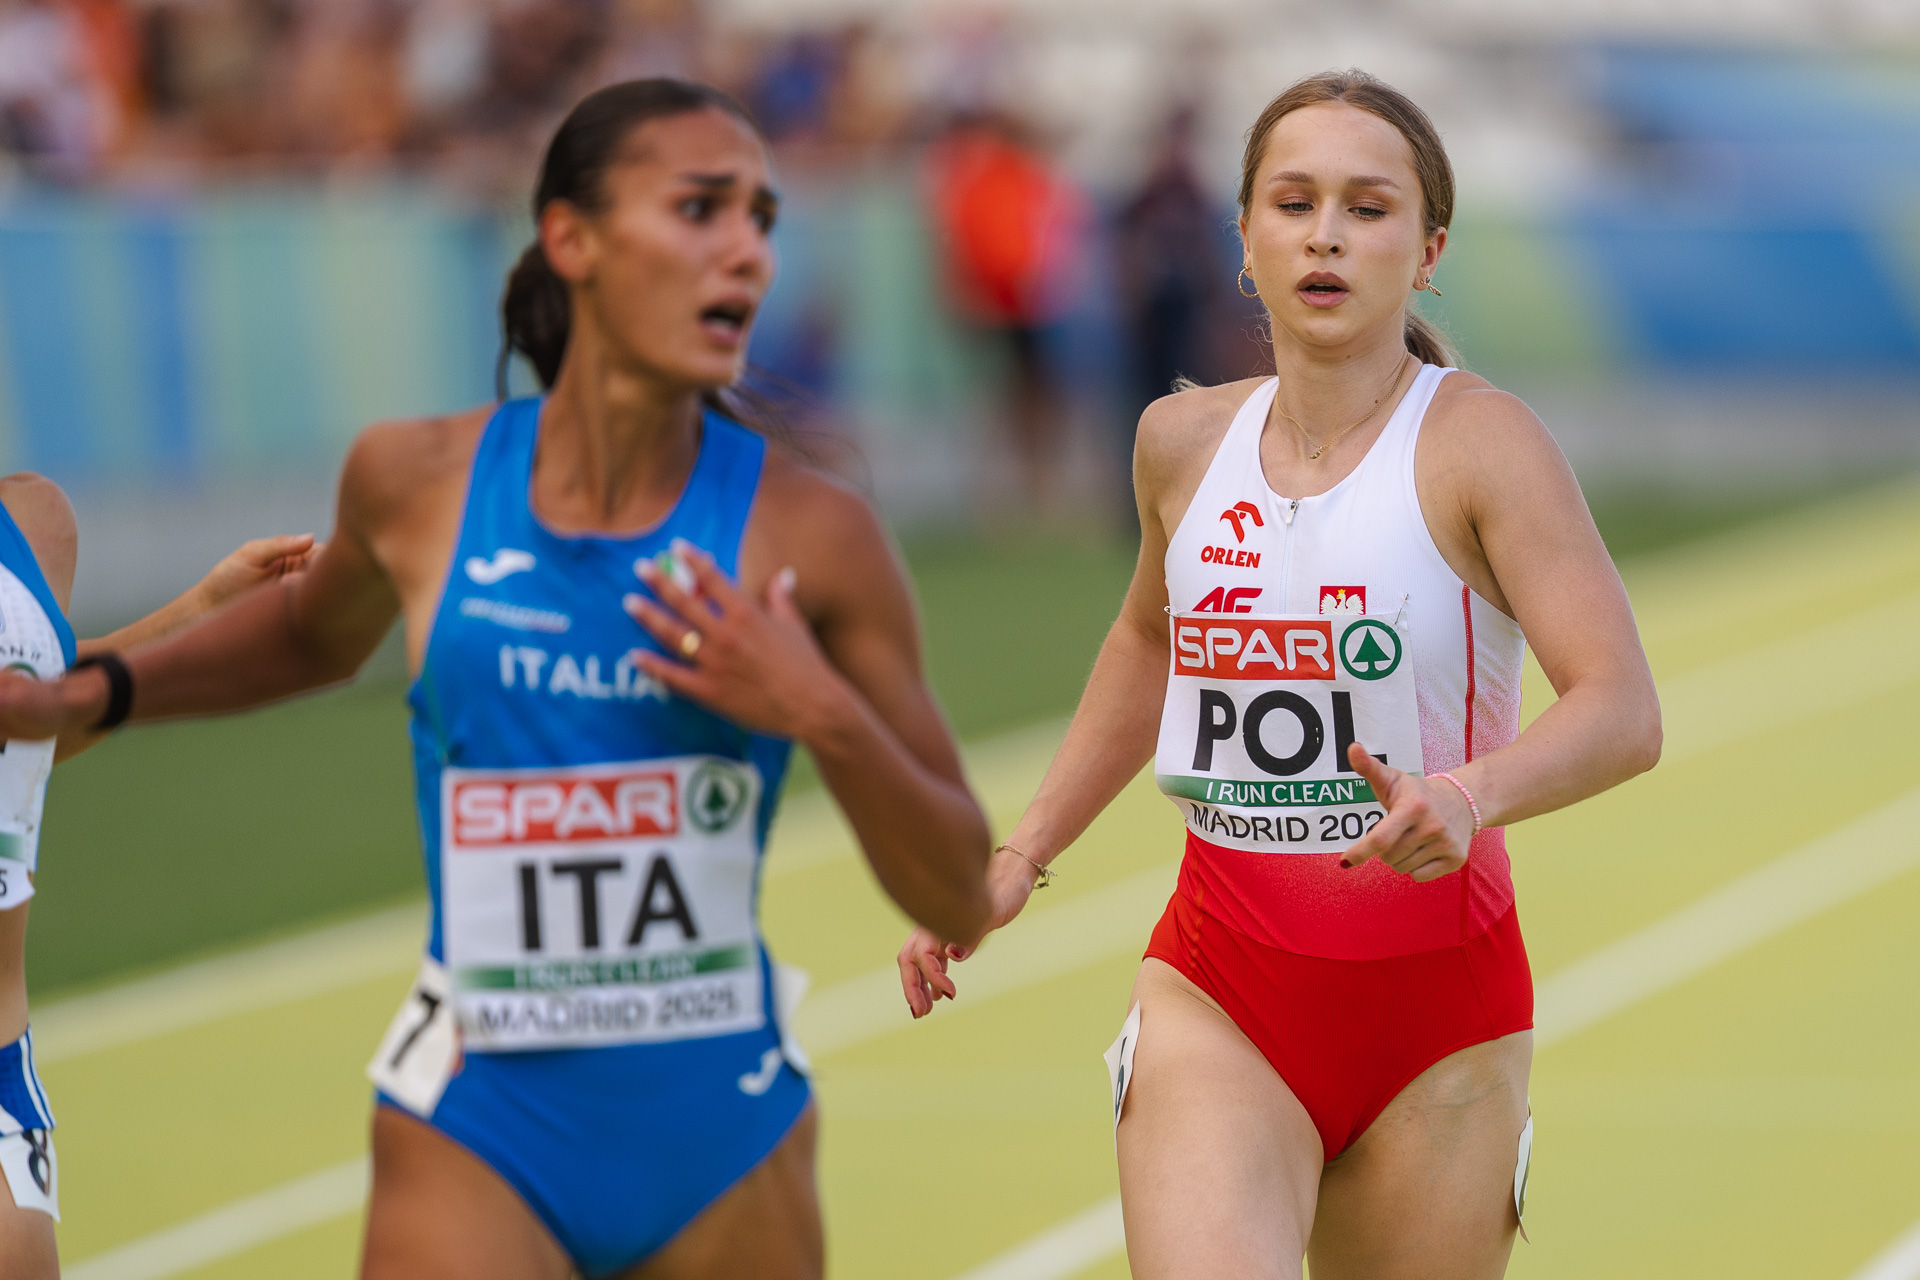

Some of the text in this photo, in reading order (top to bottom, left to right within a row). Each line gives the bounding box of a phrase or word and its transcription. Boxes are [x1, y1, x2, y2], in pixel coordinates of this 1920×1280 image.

[1200, 545, 1262, 569] ORLEN
[1177, 625, 1330, 671] SPAR
[1192, 688, 1388, 777] POL
[456, 778, 675, 841] SPAR
[1205, 781, 1214, 800] I
[1218, 783, 1266, 804] RUN
[1189, 802, 1385, 842] MADRID 202
[519, 853, 698, 952] ITA
[388, 990, 441, 1071] 7
